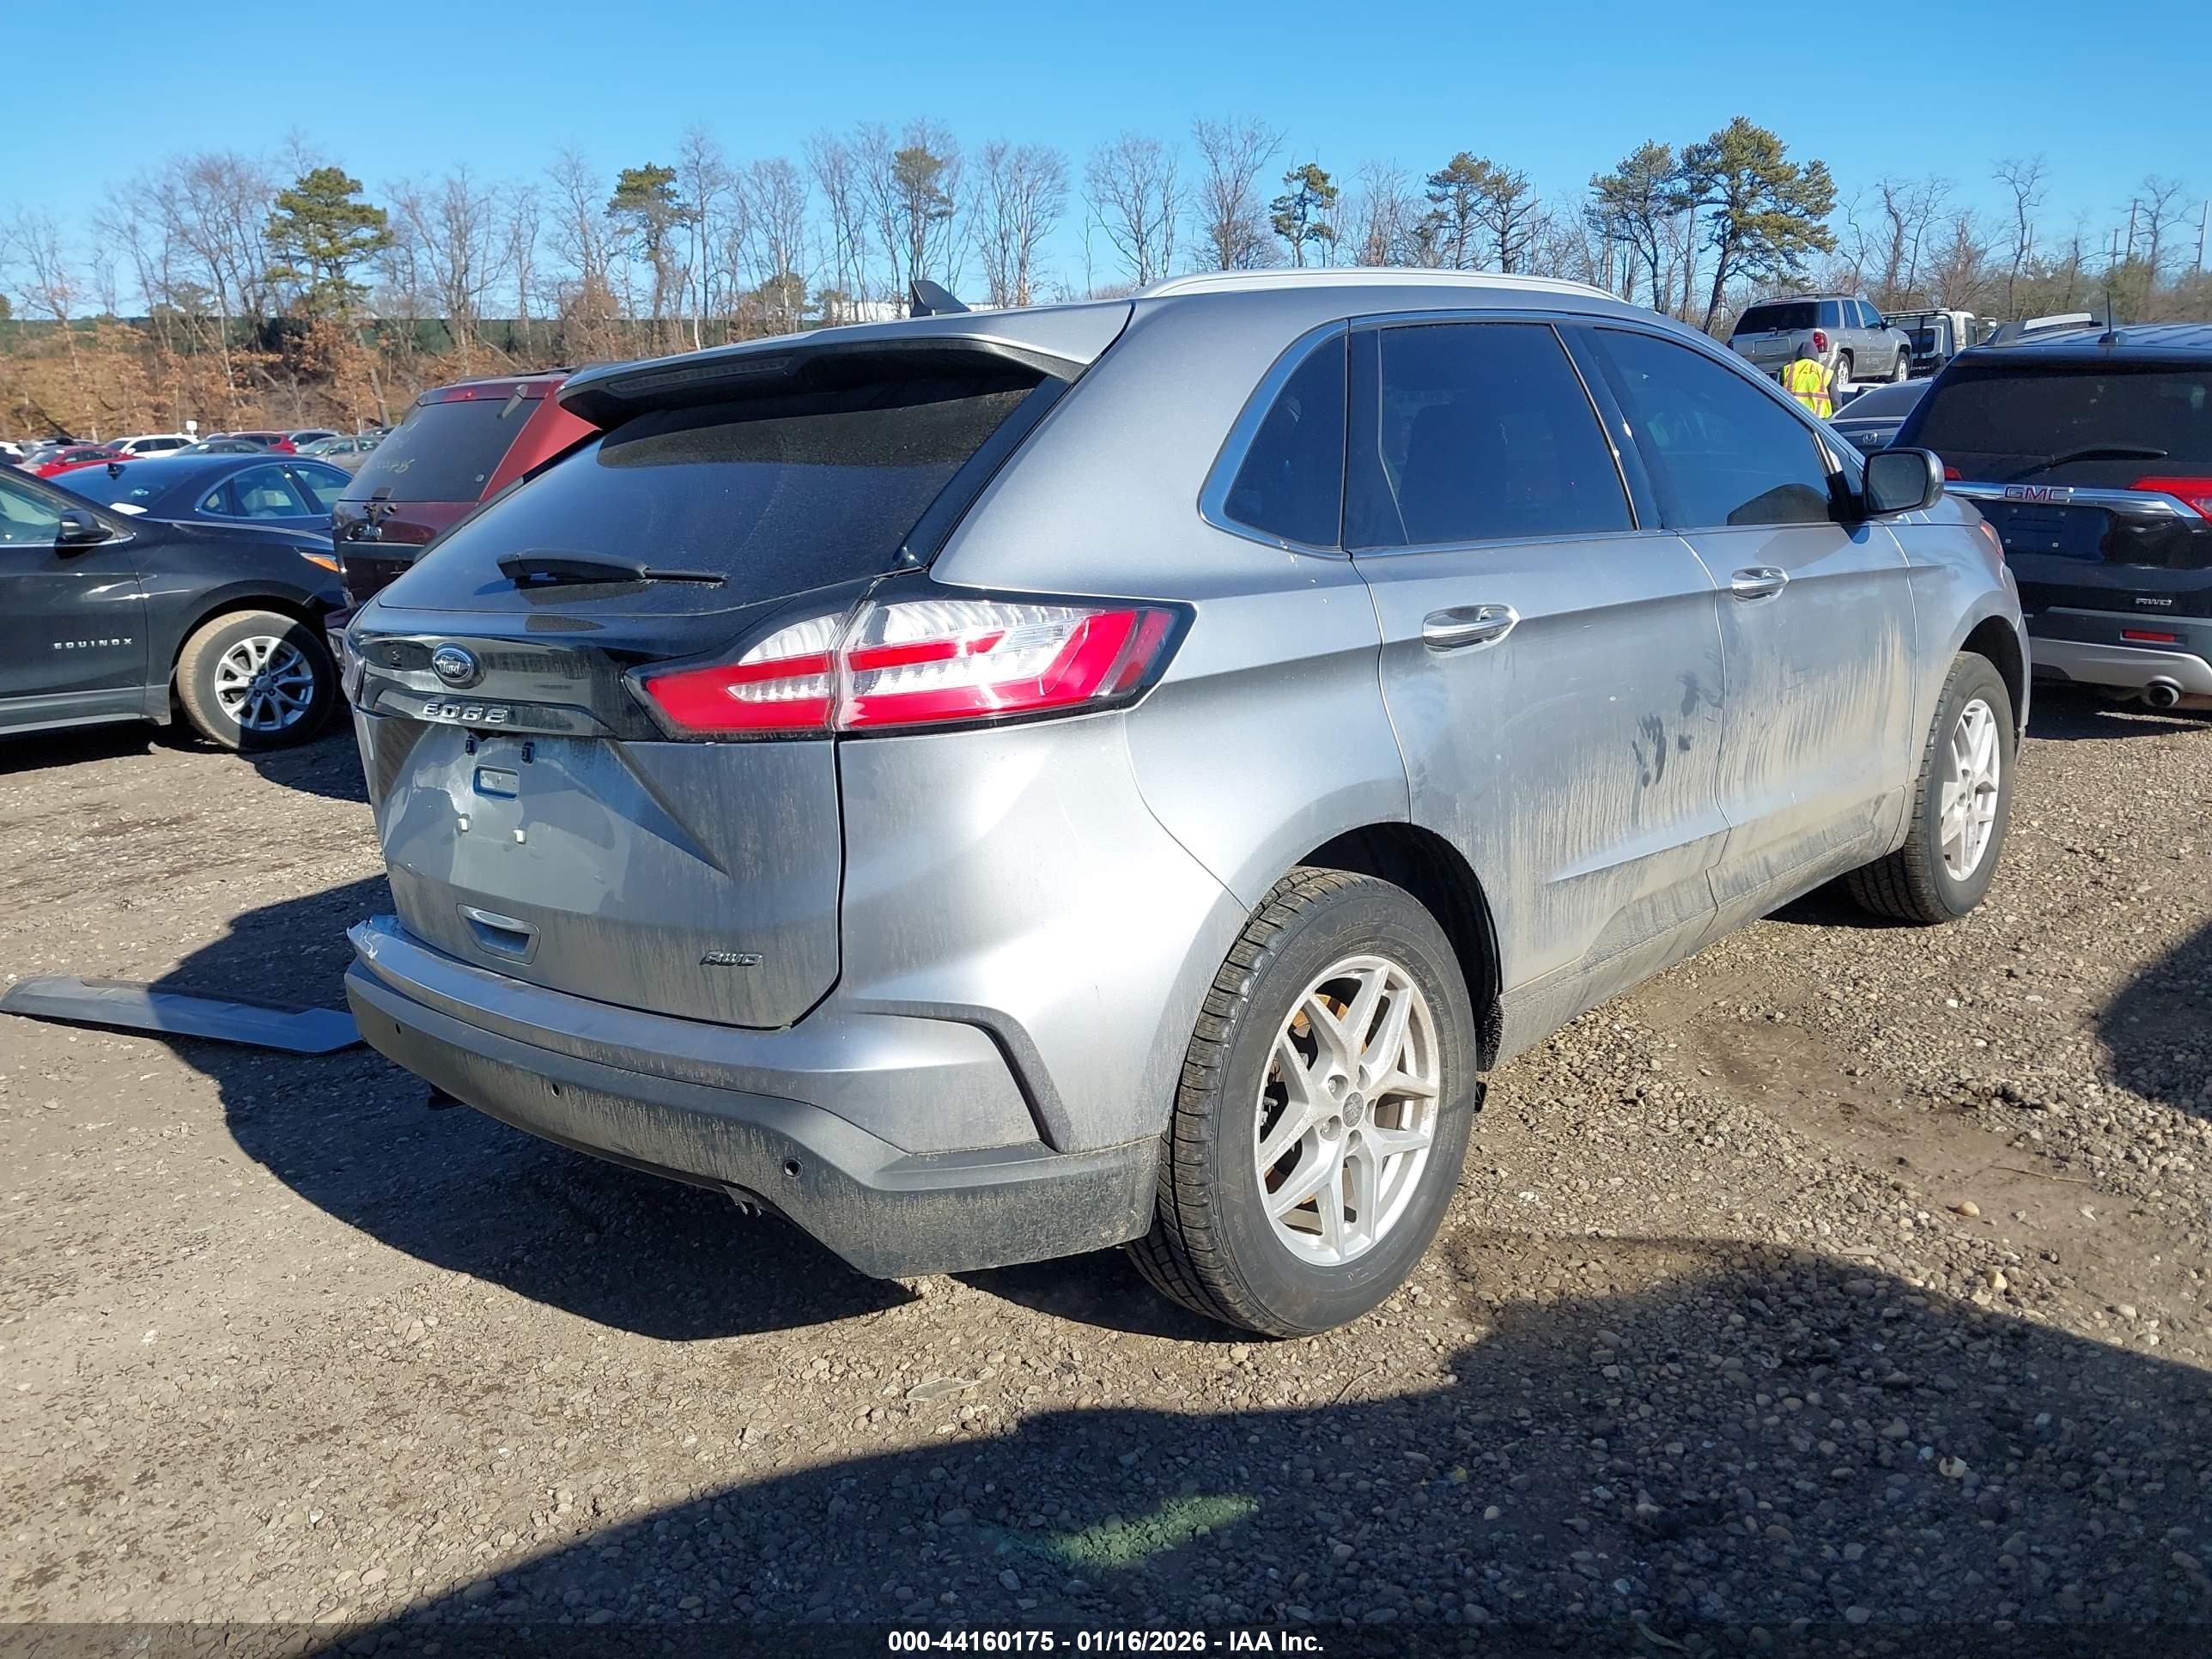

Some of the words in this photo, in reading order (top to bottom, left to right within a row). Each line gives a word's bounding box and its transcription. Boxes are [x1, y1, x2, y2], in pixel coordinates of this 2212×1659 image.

[2004, 484, 2074, 504] GMC
[53, 638, 132, 650] EQUINOX
[437, 654, 462, 675] Ford
[422, 702, 508, 723] EDGE
[702, 950, 763, 965] AWD
